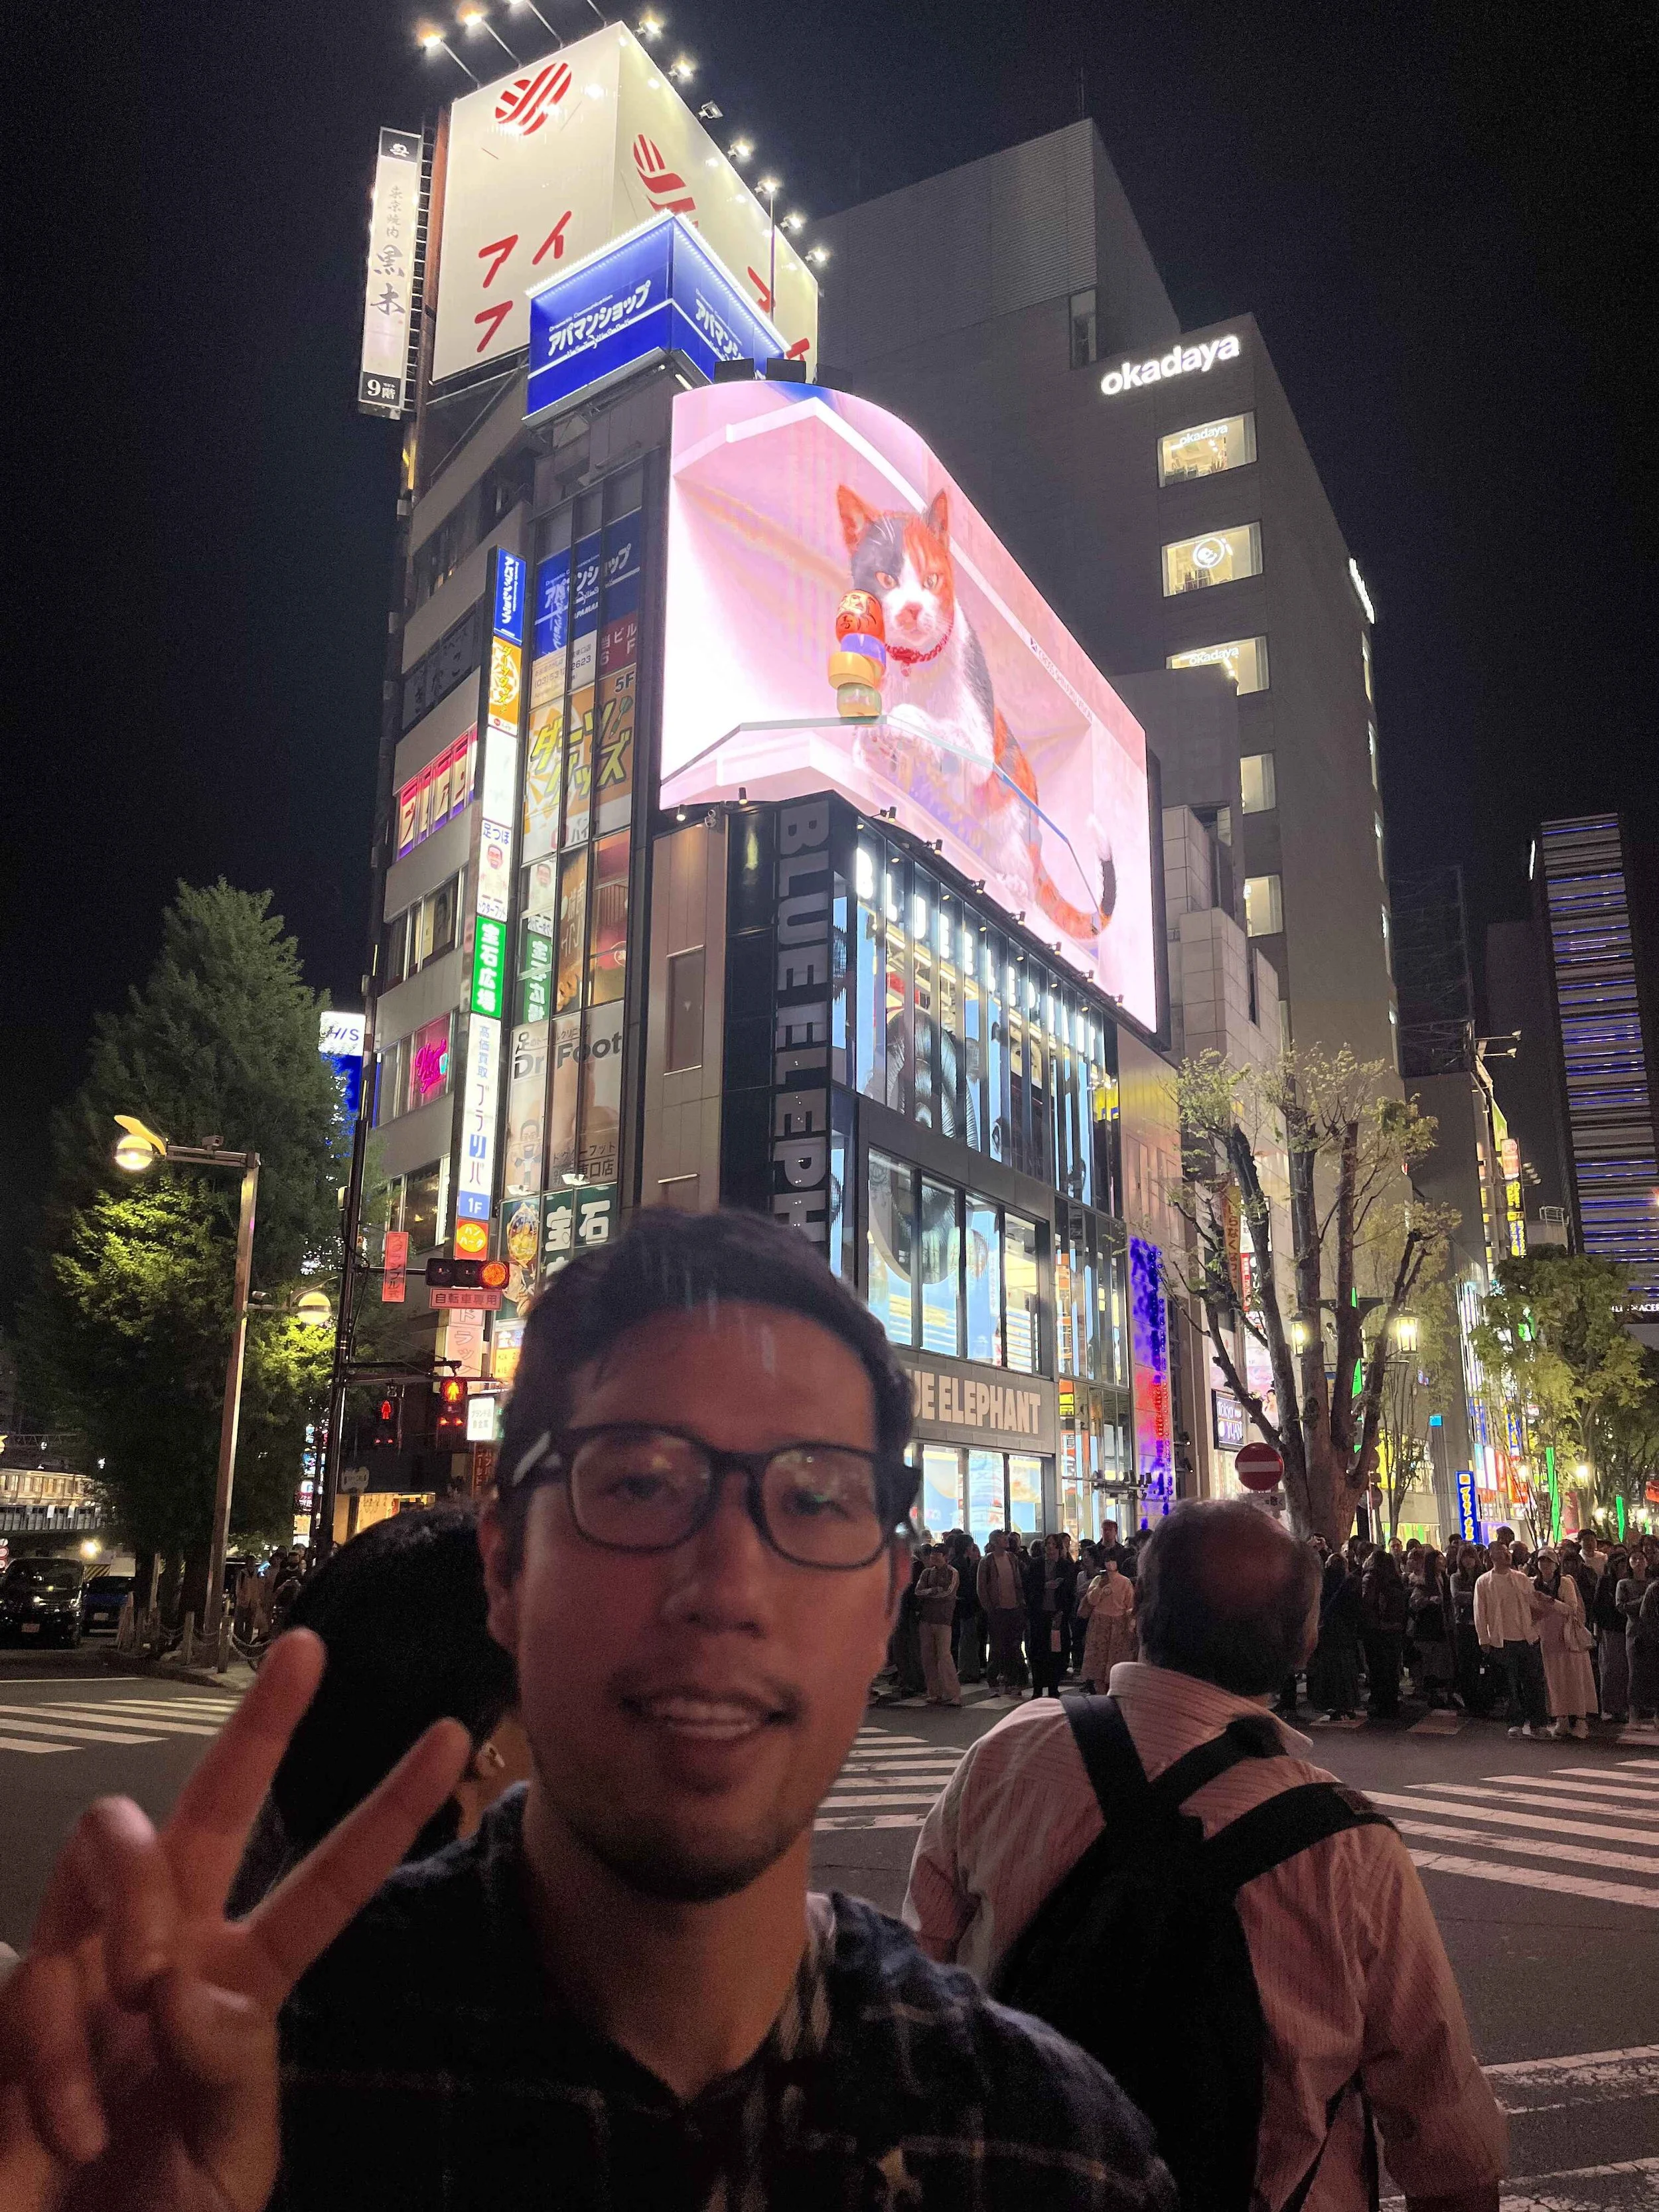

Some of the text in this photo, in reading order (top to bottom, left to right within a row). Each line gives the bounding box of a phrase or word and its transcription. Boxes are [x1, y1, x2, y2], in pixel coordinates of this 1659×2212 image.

[479, 210, 573, 287] アイ
[370, 244, 406, 316] 黒木
[474, 301, 513, 352] フ
[548, 279, 651, 356] アパマンショップ
[1101, 334, 1240, 396] okadaya
[1179, 423, 1228, 445] okadaya
[545, 543, 631, 608] アパンシップ
[614, 671, 634, 694] 5F
[476, 922, 500, 1013] 宝石広場
[514, 1031, 622, 1079] Dr Foot
[772, 1001, 829, 1243] ELEPH
[553, 1159, 614, 1185] 新東口店
[469, 1198, 482, 1213] 1F
[545, 1201, 611, 1252] 宝石
[435, 1293, 497, 1305] 自転車専用
[905, 1368, 1041, 1434] UE ELEPHANT
